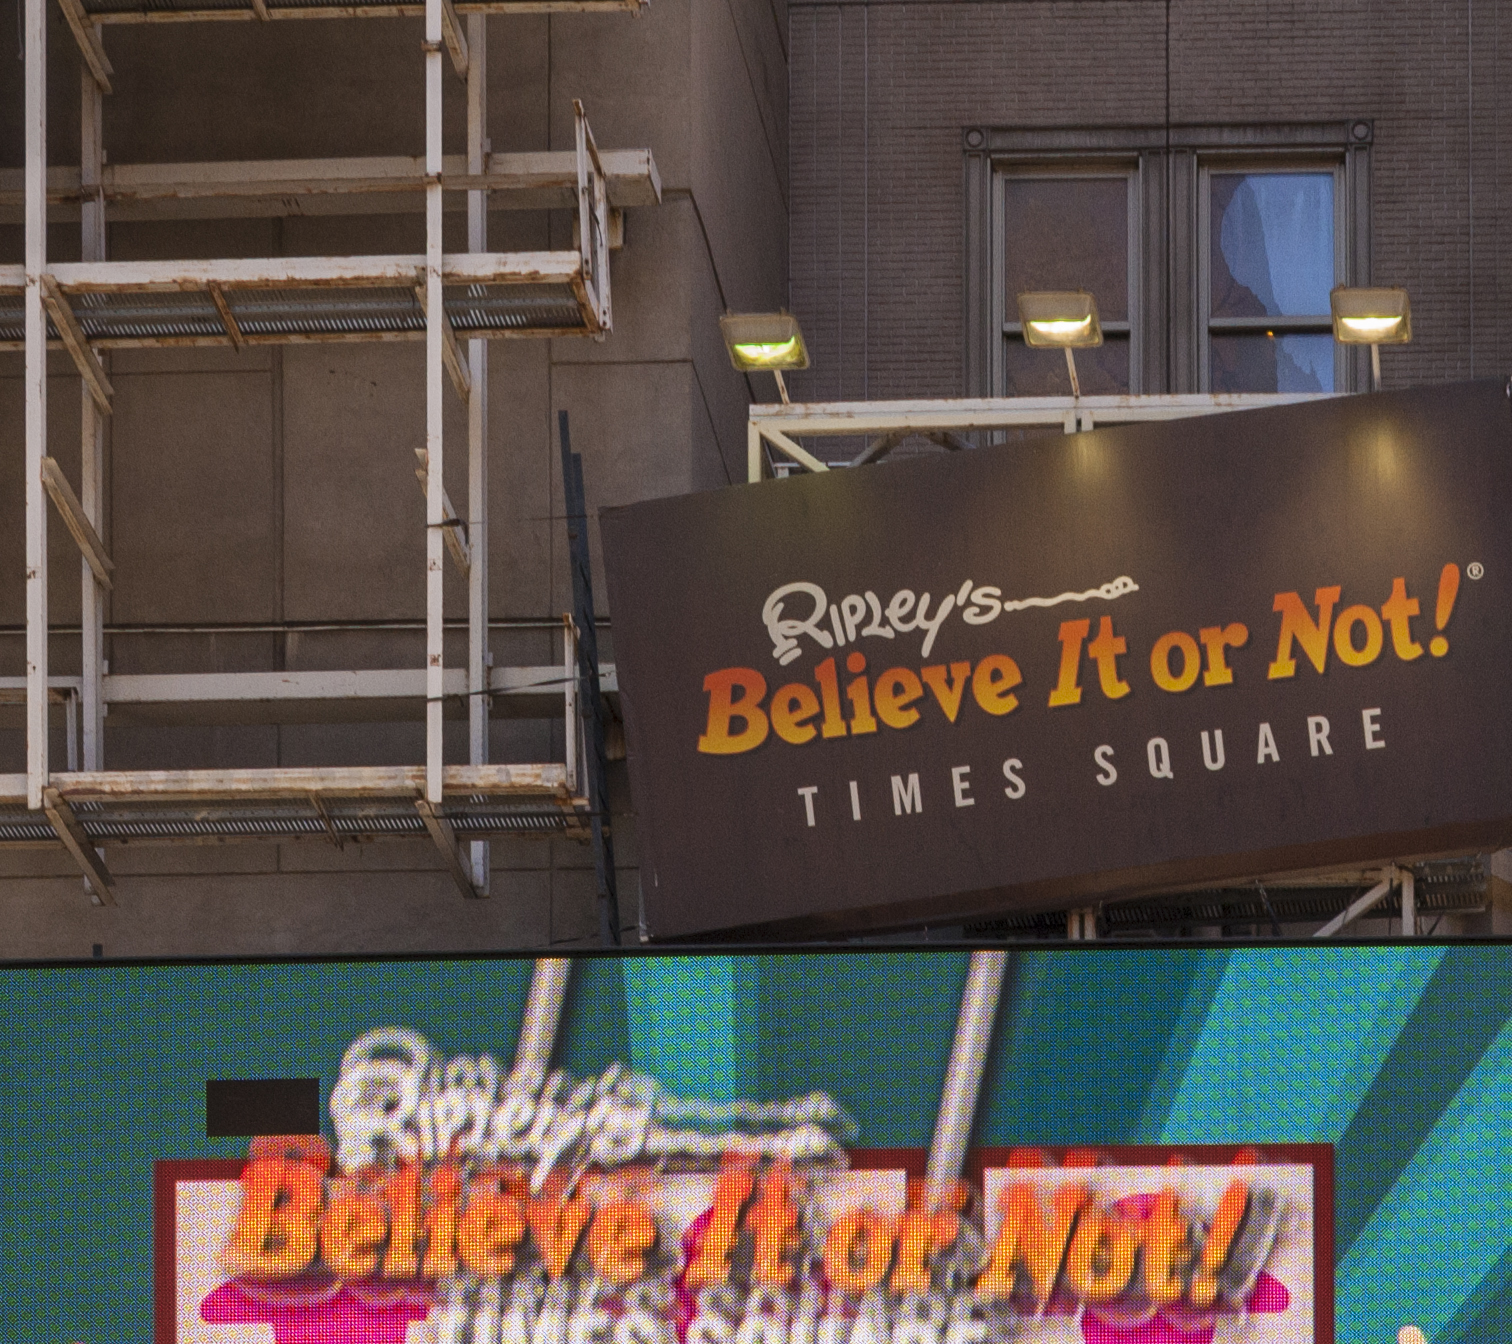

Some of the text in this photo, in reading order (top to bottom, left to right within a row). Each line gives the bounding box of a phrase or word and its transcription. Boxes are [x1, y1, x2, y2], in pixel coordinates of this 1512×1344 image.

[697, 562, 1462, 756] Believe It or Not!
[797, 706, 1387, 828] TIMES SQUARE
[224, 1140, 660, 1290] Believe
[684, 1150, 802, 1290] It
[823, 1178, 968, 1292] or
